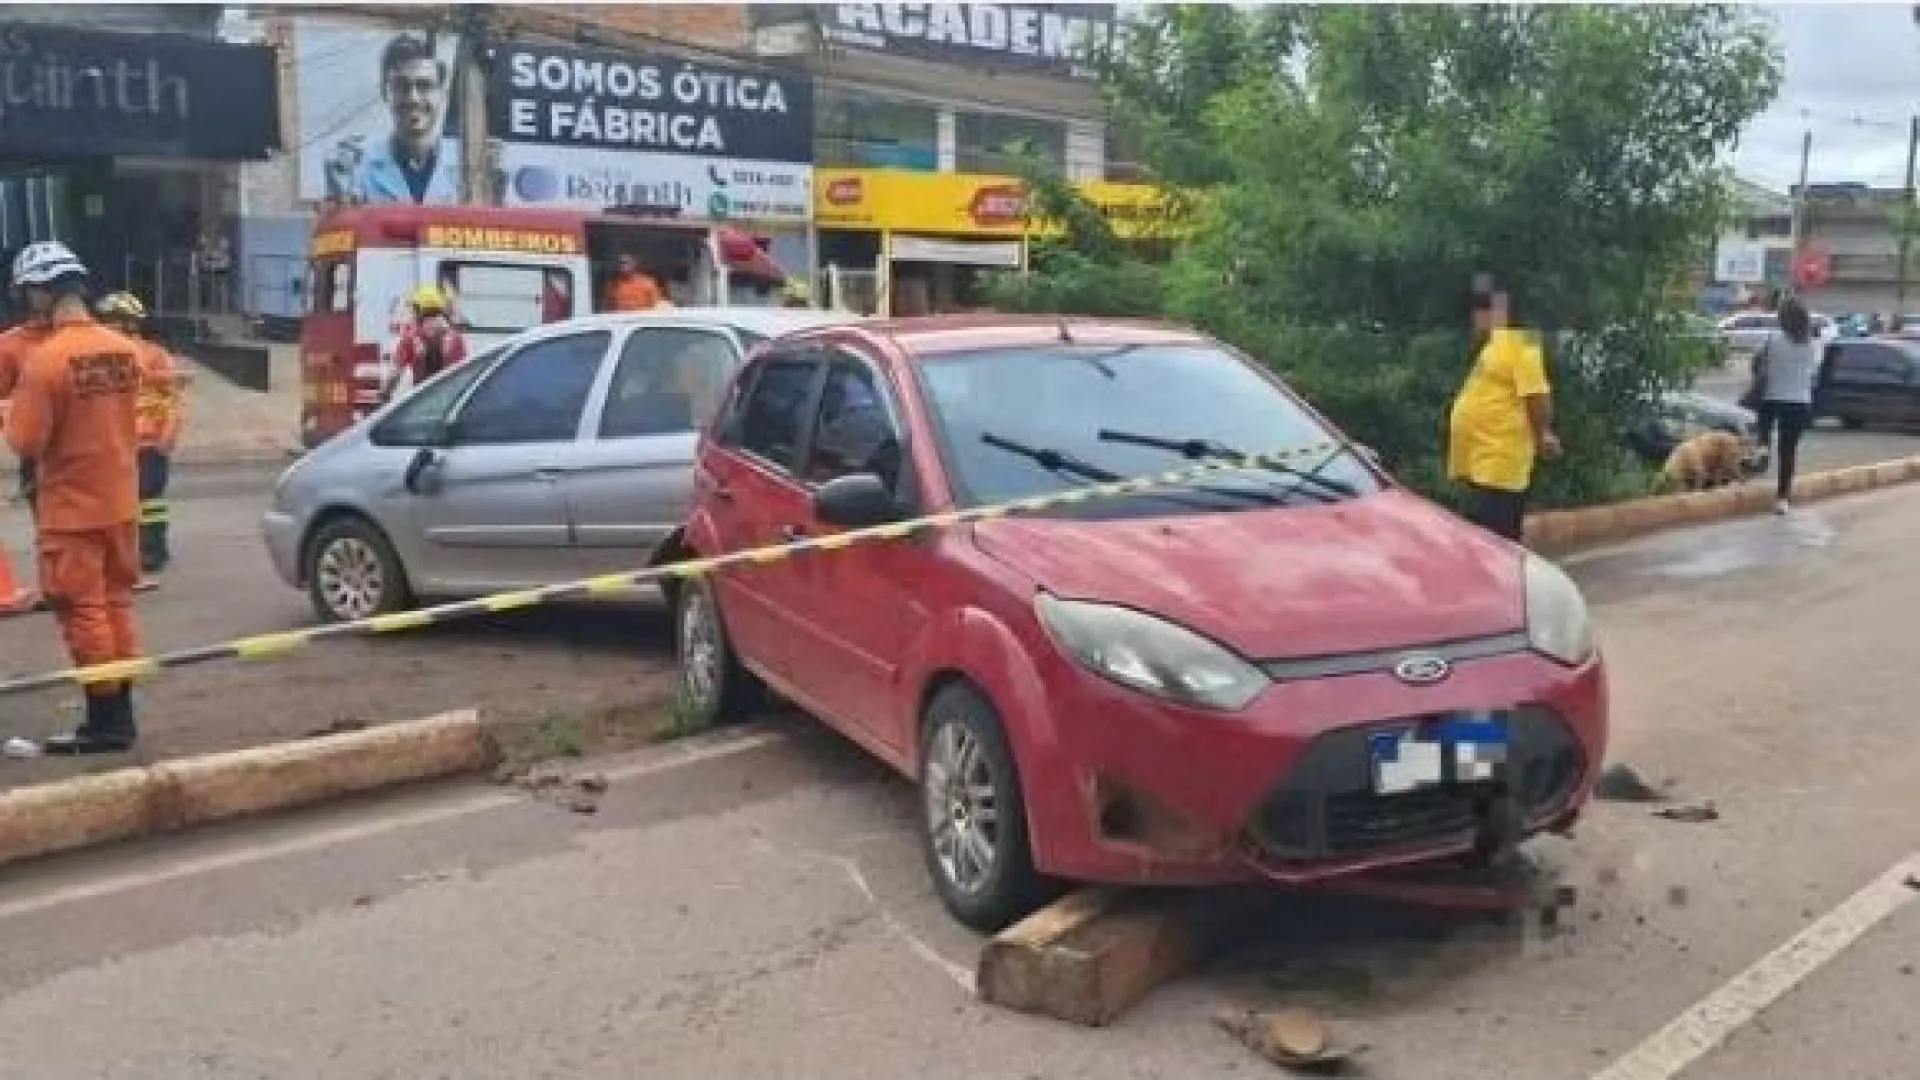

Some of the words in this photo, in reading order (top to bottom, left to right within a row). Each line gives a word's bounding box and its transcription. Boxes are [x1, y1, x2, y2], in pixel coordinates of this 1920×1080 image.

[511, 52, 663, 99] SOMOS
[672, 63, 787, 113] ÓTICA
[510, 98, 538, 134] E
[550, 96, 725, 150] FÁBRICA
[426, 225, 578, 252] BOMBEIROS
